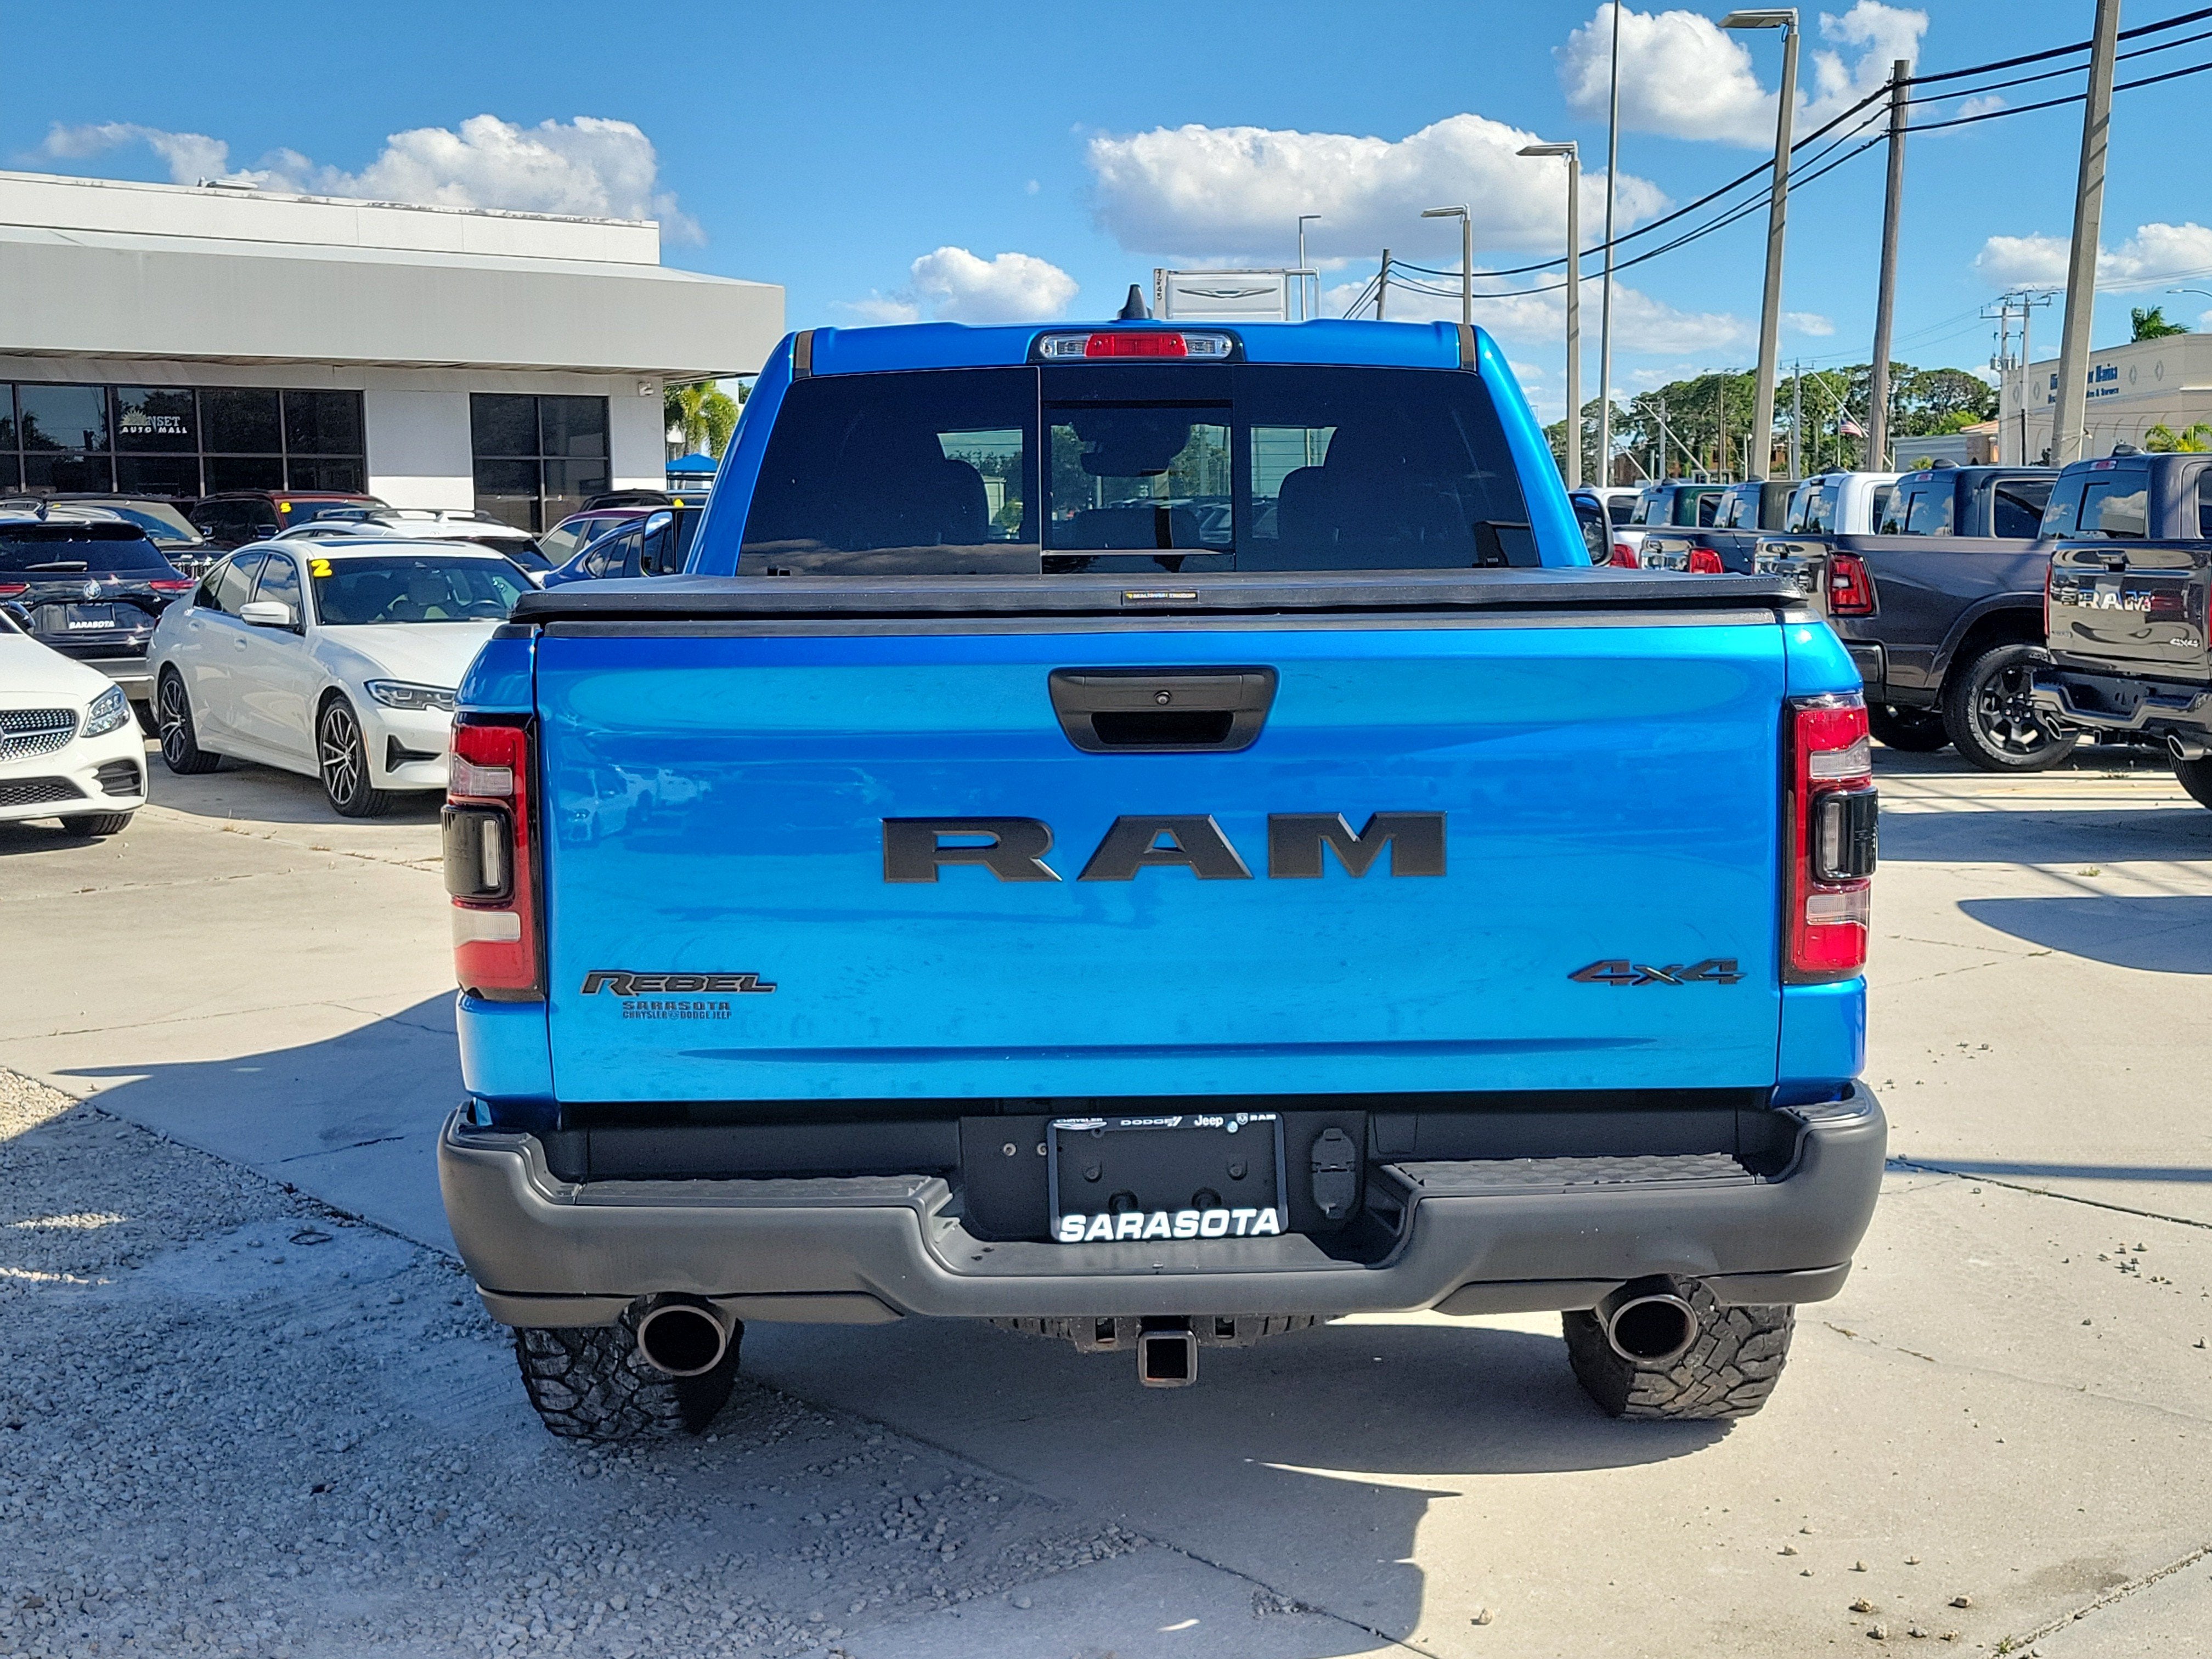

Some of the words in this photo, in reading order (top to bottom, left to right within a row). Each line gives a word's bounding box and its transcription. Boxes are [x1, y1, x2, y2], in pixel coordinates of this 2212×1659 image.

[129, 415, 180, 427] NSET
[311, 558, 332, 577] 2
[2078, 588, 2152, 612] RAM
[881, 811, 1448, 883] RAM
[579, 969, 777, 997] REBEL
[622, 1001, 731, 1011] SARASOTA
[622, 1011, 668, 1019] CHRYSLER
[680, 1011, 710, 1019] DODGE
[713, 1011, 732, 1019] JEEP
[1194, 1114, 1224, 1127] Jeep
[1059, 1207, 1281, 1243] SARASOTA
